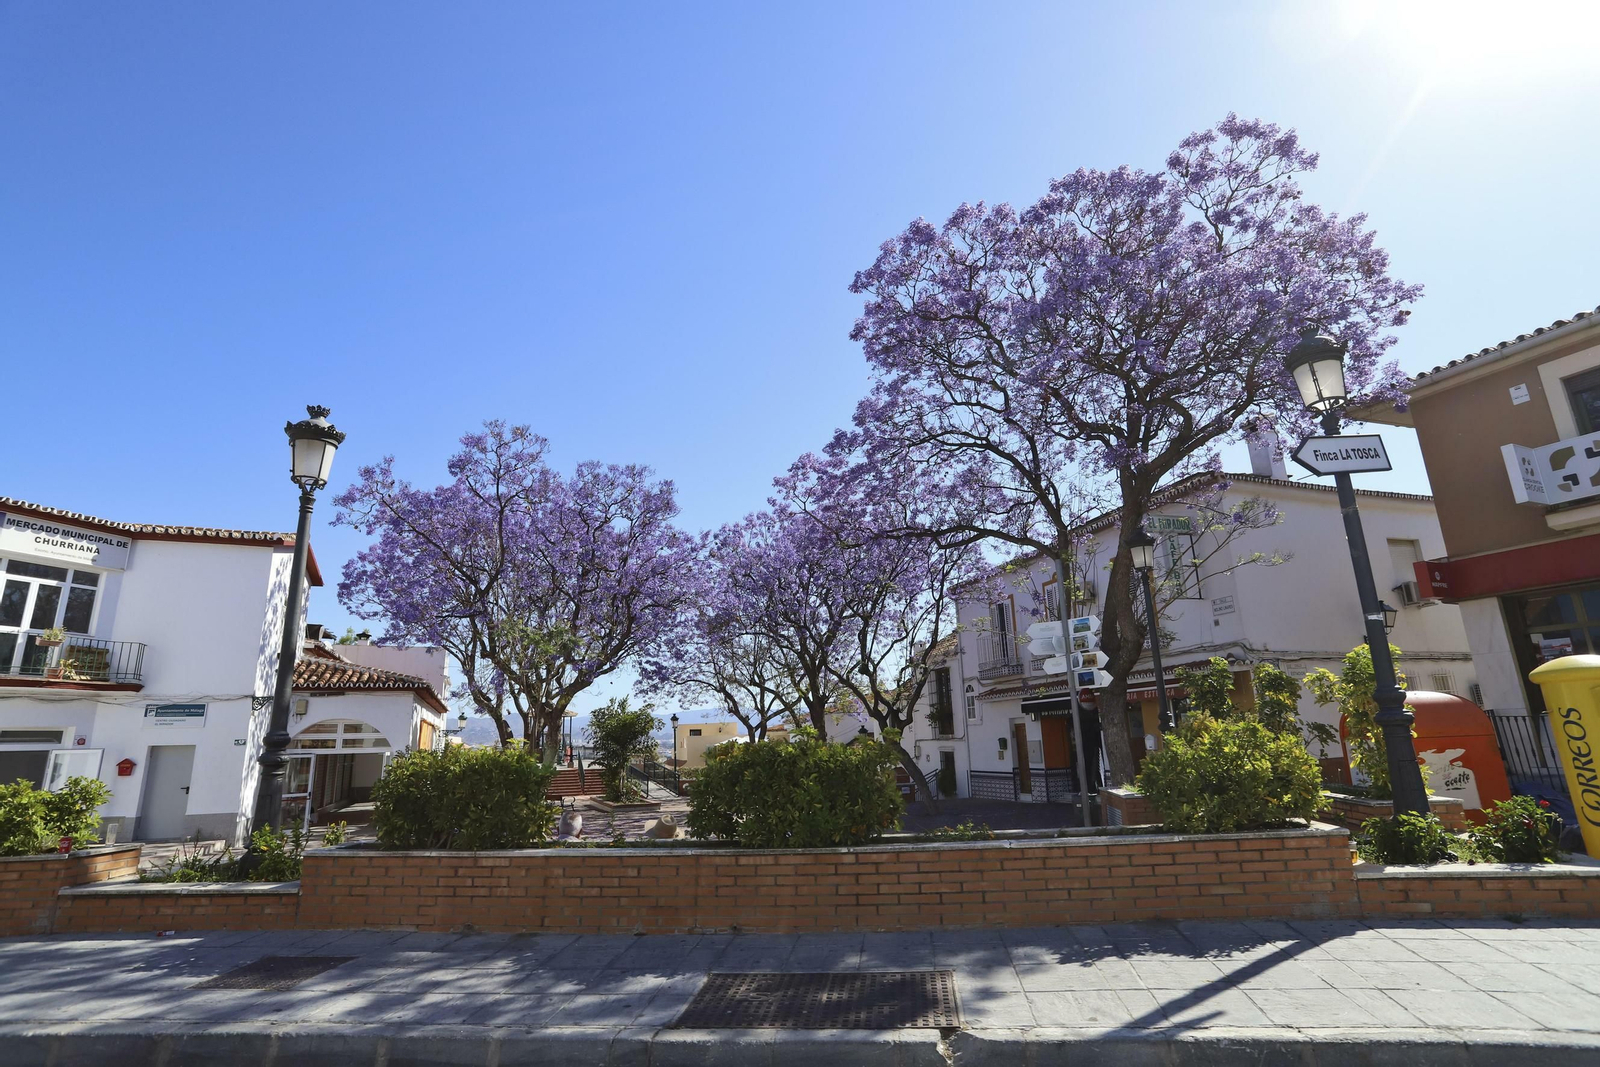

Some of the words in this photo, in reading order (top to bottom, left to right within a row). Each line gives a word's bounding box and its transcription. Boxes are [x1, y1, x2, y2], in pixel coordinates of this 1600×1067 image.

[1313, 449, 1339, 461] Finca
[1351, 447, 1381, 459] TOSCA
[6, 518, 60, 535] MERCADO
[61, 529, 115, 546] MUNICIPAL
[34, 536, 100, 554] CHURRIANA
[1558, 707, 1600, 827] CORREOS
